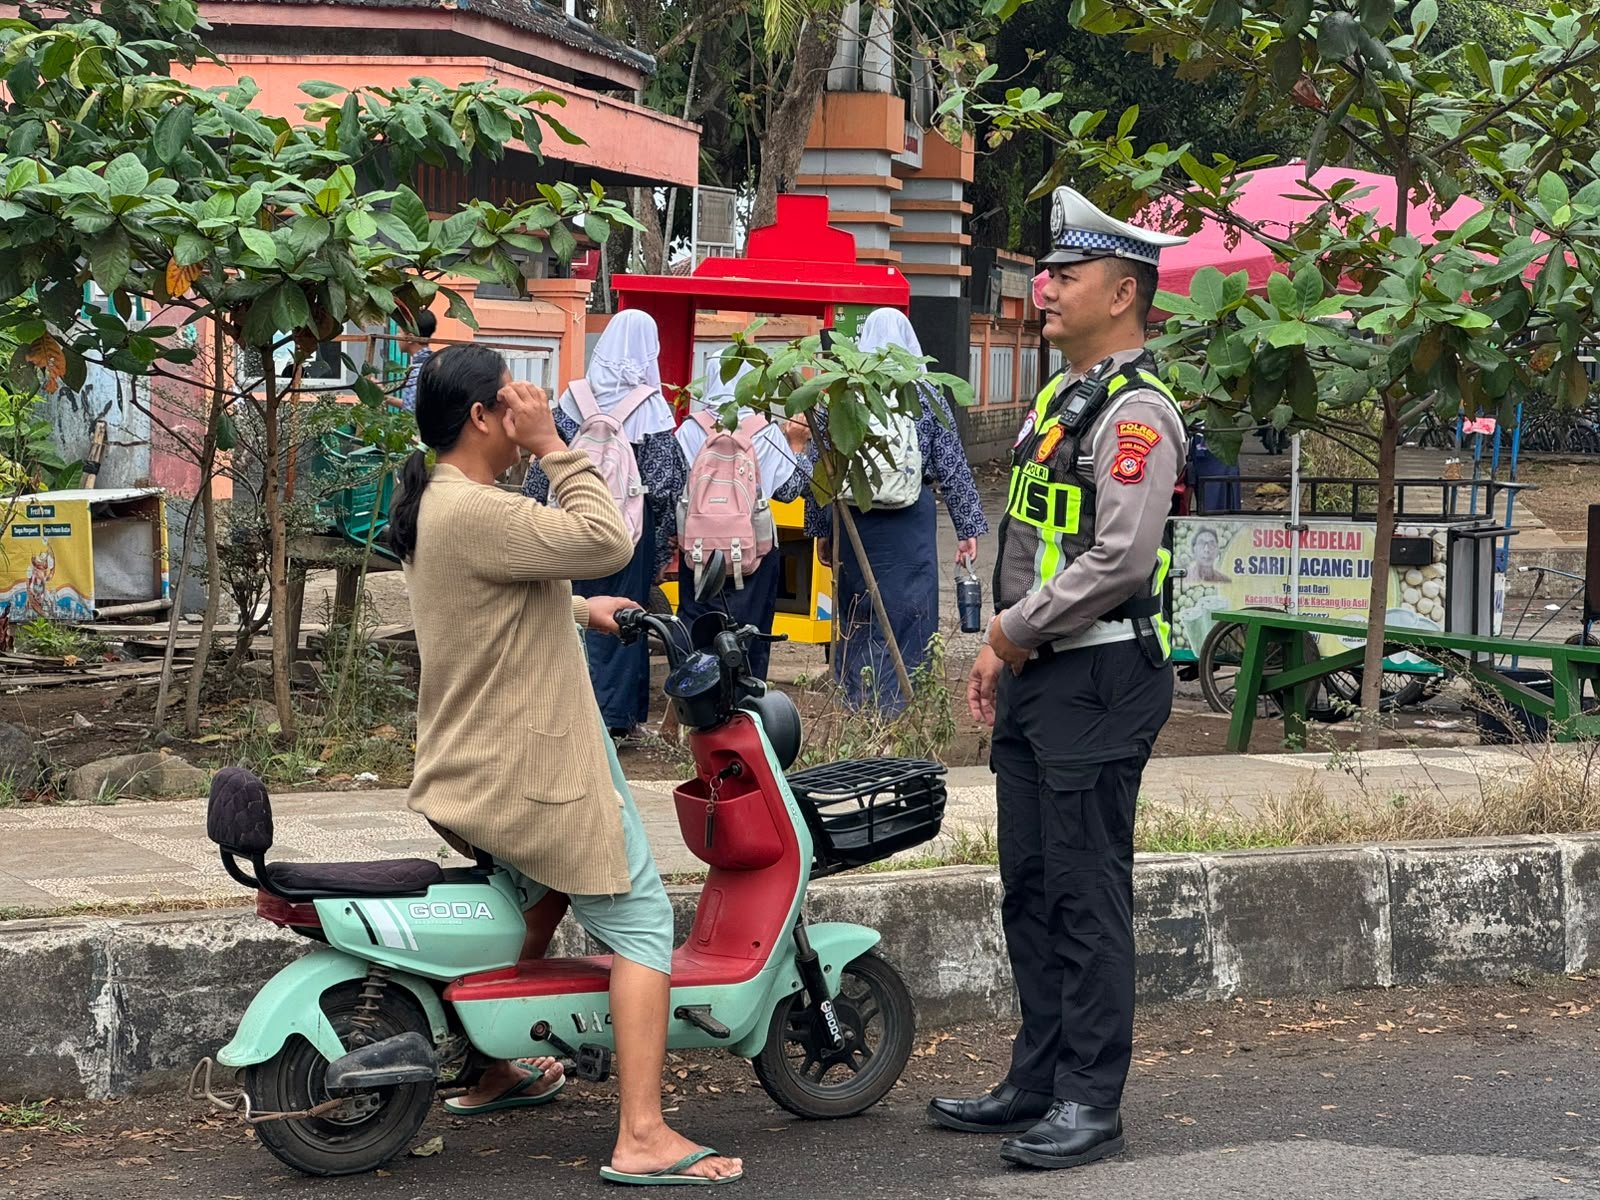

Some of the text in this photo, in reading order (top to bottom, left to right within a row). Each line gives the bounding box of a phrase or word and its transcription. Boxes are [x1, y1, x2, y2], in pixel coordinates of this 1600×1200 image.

[1119, 423, 1159, 441] POLRES
[1026, 463, 1047, 479] POLRI
[1252, 529, 1362, 550] SUSU KEDELAI
[1233, 557, 1245, 575] &
[1248, 556, 1285, 576] SARI
[1357, 559, 1374, 578] IJ
[1282, 583, 1329, 594] Teuat Dari
[1311, 597, 1340, 608] Kacang
[408, 901, 495, 920] GODA
[825, 1011, 842, 1042] GODA
